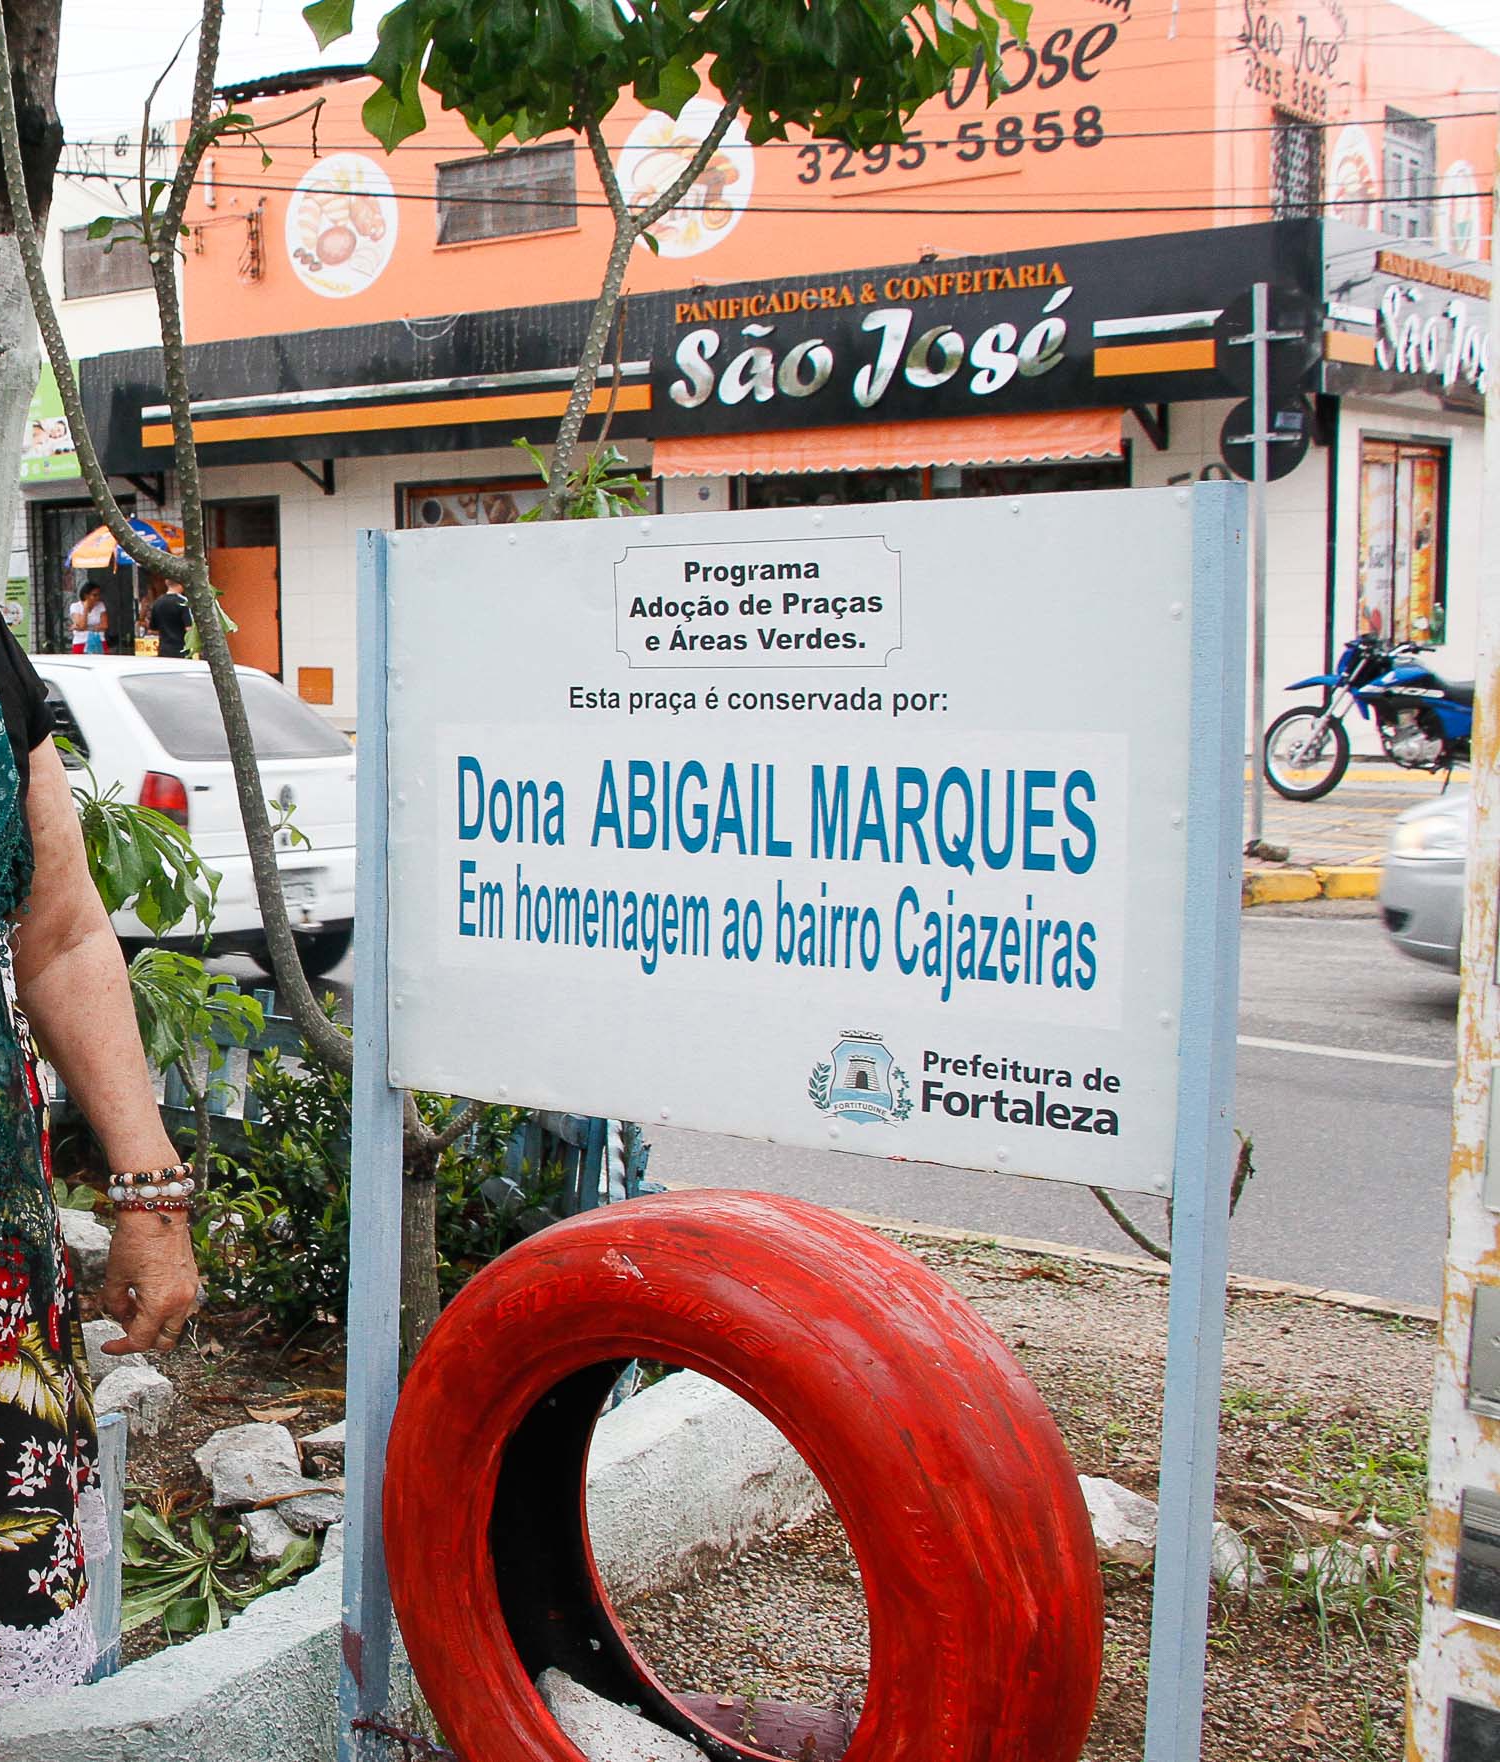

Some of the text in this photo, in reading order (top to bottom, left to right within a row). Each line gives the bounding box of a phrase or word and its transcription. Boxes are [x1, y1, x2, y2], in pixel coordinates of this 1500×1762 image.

[675, 262, 1067, 324] PANIFICADORA & CONFEITARIA
[668, 286, 1073, 408] São José
[684, 561, 820, 587] Programa
[629, 592, 883, 623] Adoção de Praças
[645, 624, 866, 652] e Áreas Verdes.
[569, 686, 948, 718] Esta praça é conservada por:
[457, 755, 1097, 876] Dona ABIGAIL MARQUES
[458, 859, 1097, 1003] Em homenagem ao bairro Cajazeiras
[922, 1049, 1121, 1094] Prefeitura de
[834, 1102, 887, 1117] FORTITUDINE
[921, 1079, 1120, 1137] Fortaleza
